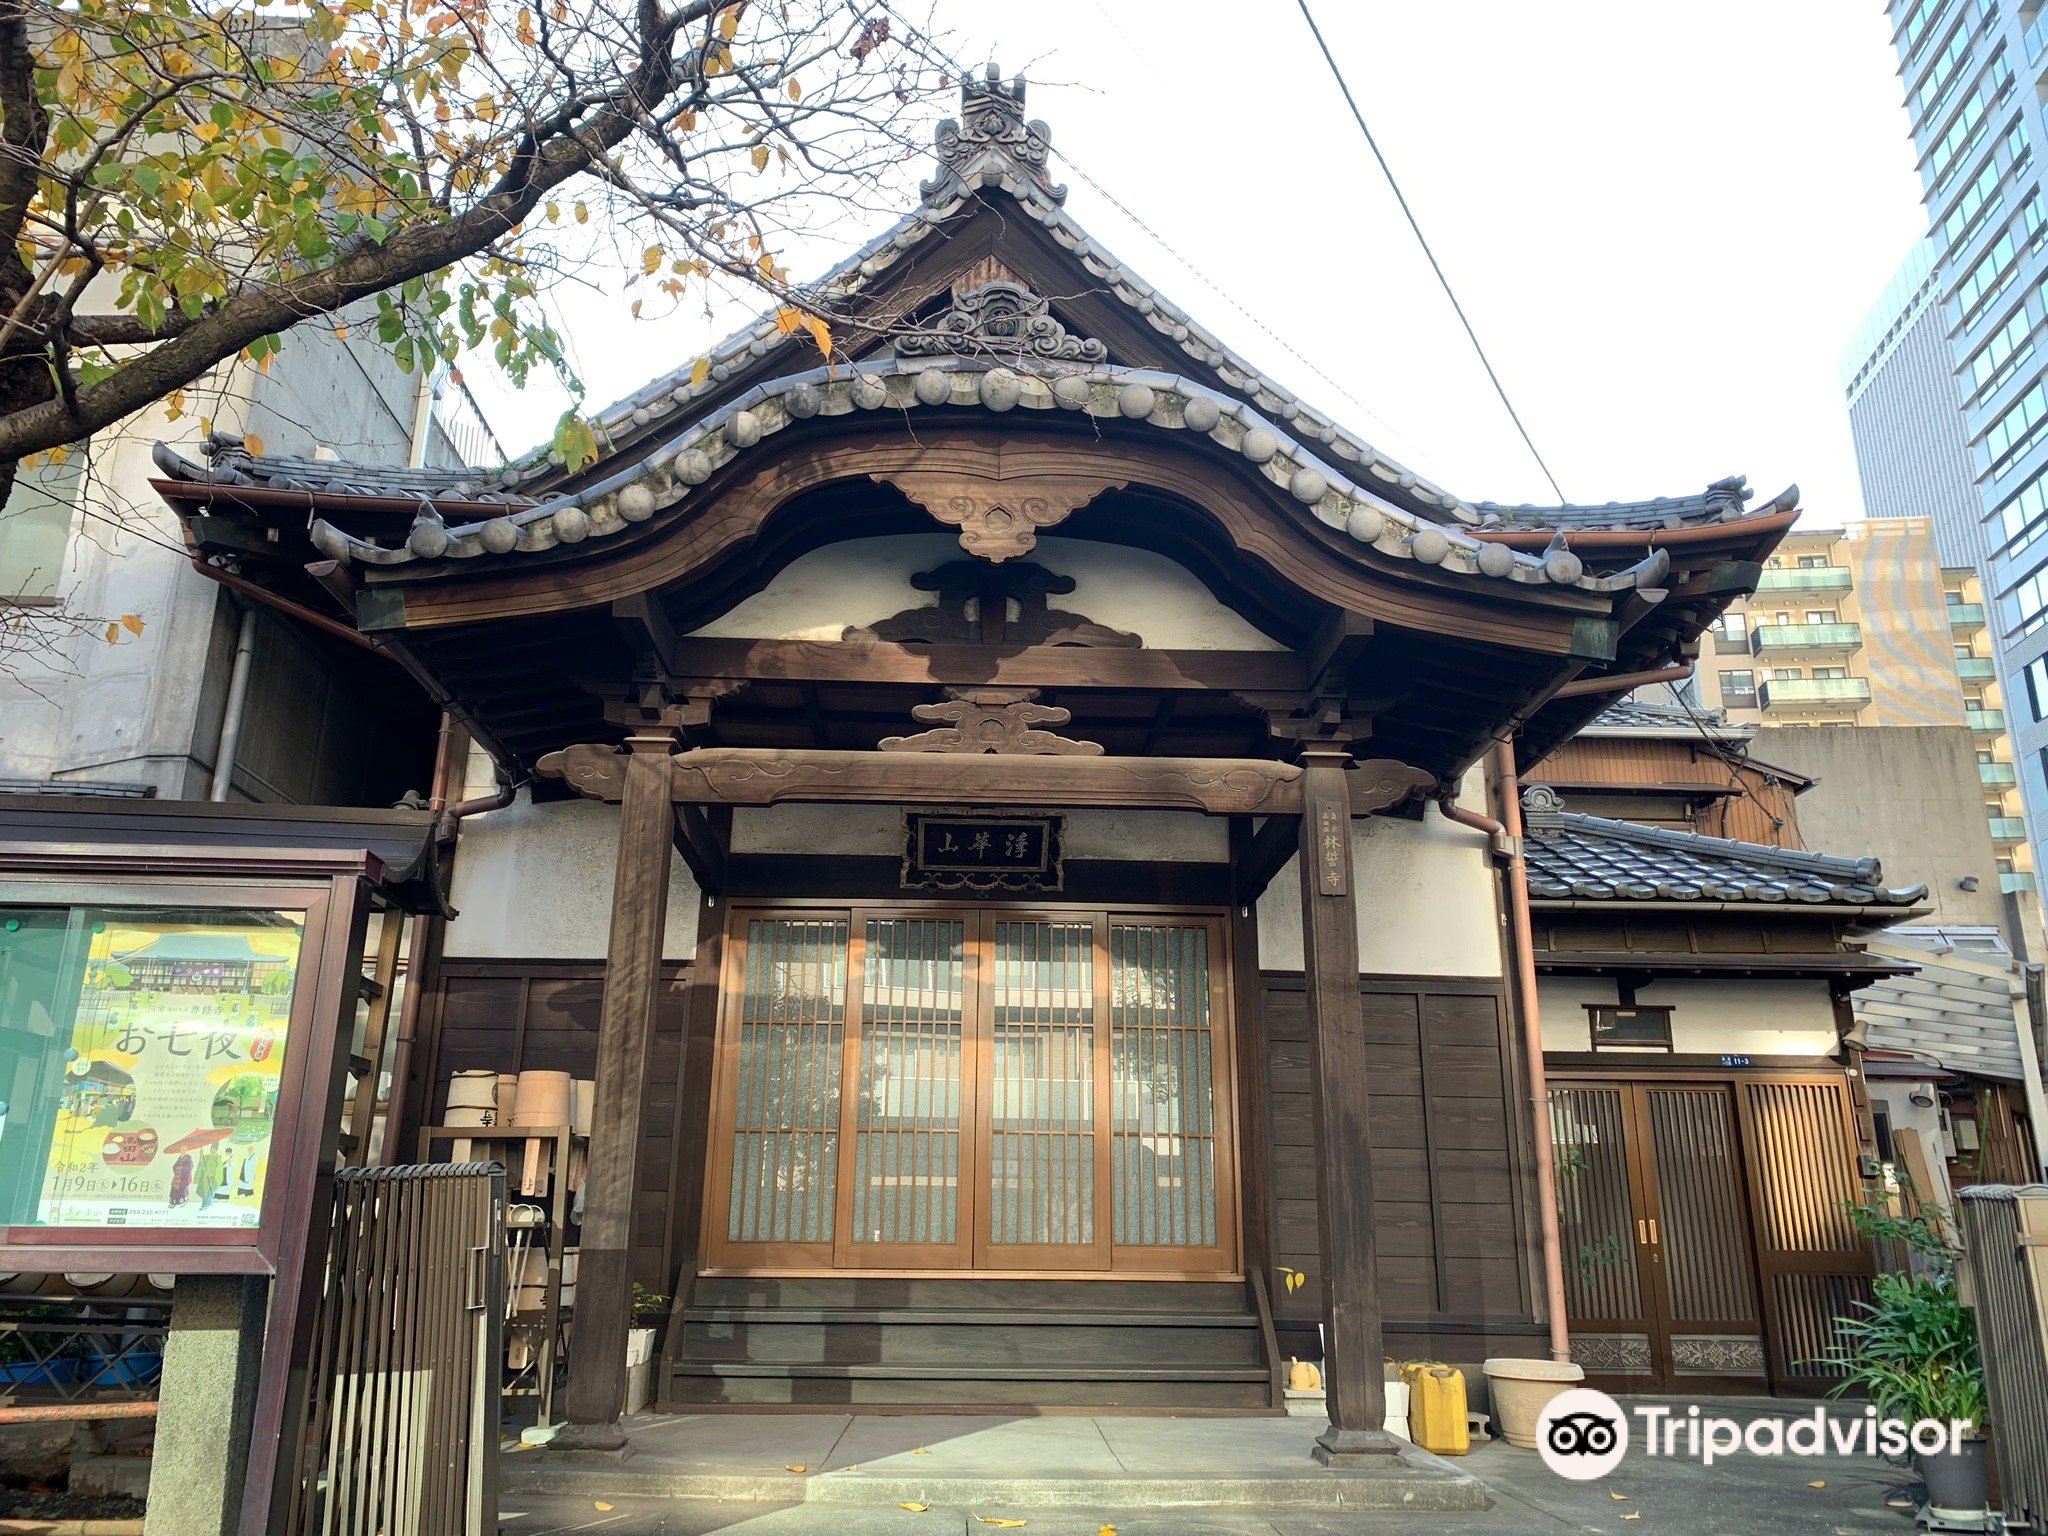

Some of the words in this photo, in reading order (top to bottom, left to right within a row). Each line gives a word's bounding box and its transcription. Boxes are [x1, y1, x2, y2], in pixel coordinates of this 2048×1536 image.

[116, 1018, 242, 1061] お七夜
[55, 1160, 99, 1173] 令和2年
